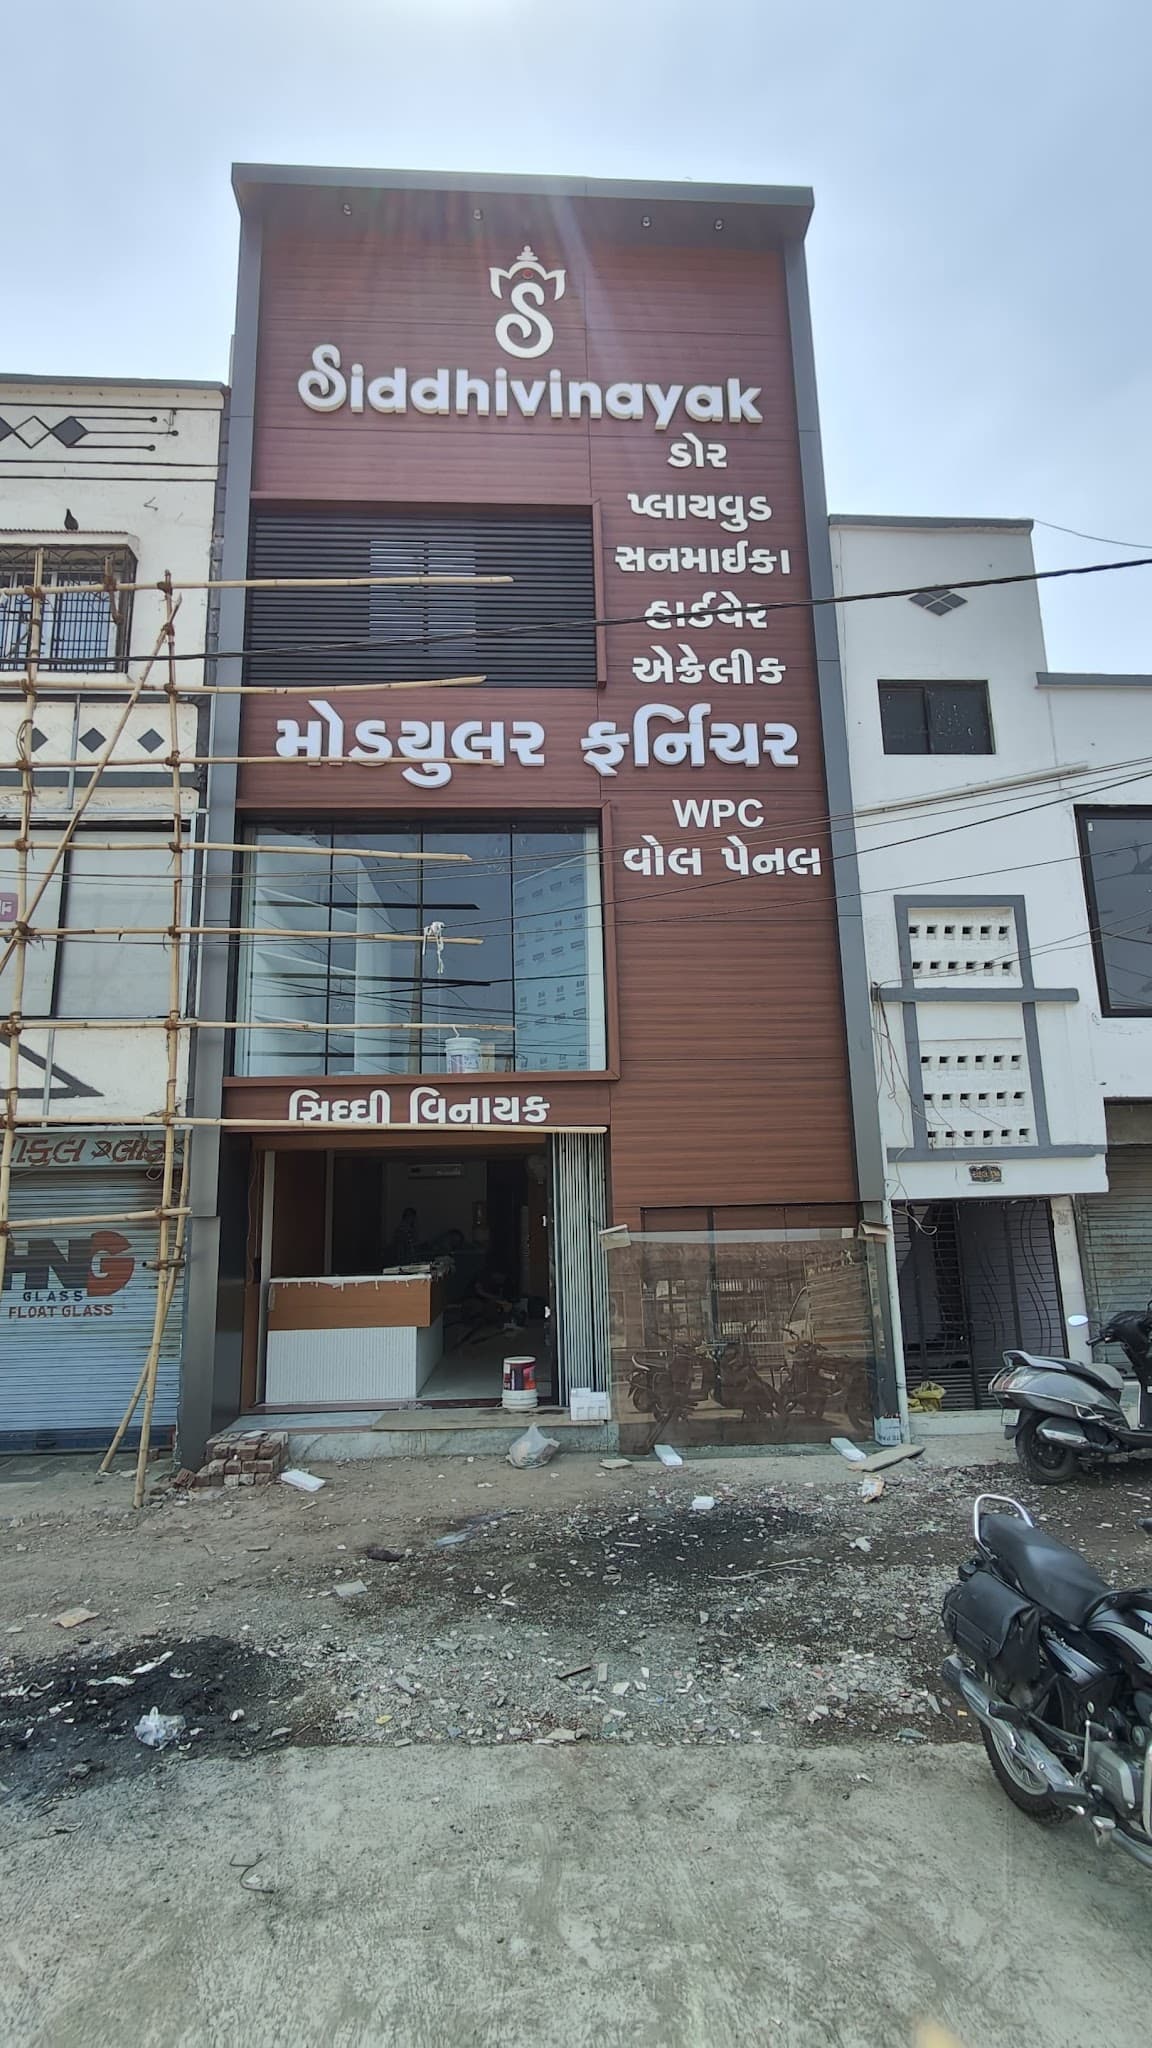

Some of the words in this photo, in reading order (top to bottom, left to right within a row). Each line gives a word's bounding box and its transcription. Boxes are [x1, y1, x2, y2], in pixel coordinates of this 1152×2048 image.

[297, 343, 764, 430] Siddhivinayak
[667, 432, 728, 468] ડોર
[627, 493, 773, 533] પ્લાયવુડ
[614, 540, 791, 575] સનમાઈકા
[643, 591, 769, 630] હાર્ડવેર
[580, 703, 800, 777] ફર્નિચર
[671, 798, 765, 828] WPC
[623, 834, 703, 877] વોલ
[721, 835, 823, 877] પેનલ
[409, 1085, 551, 1125] વિનાયક
[8, 1305, 57, 1319] FLOAT
[62, 1303, 114, 1318] GLASS
[23, 1290, 84, 1302] GLASS
